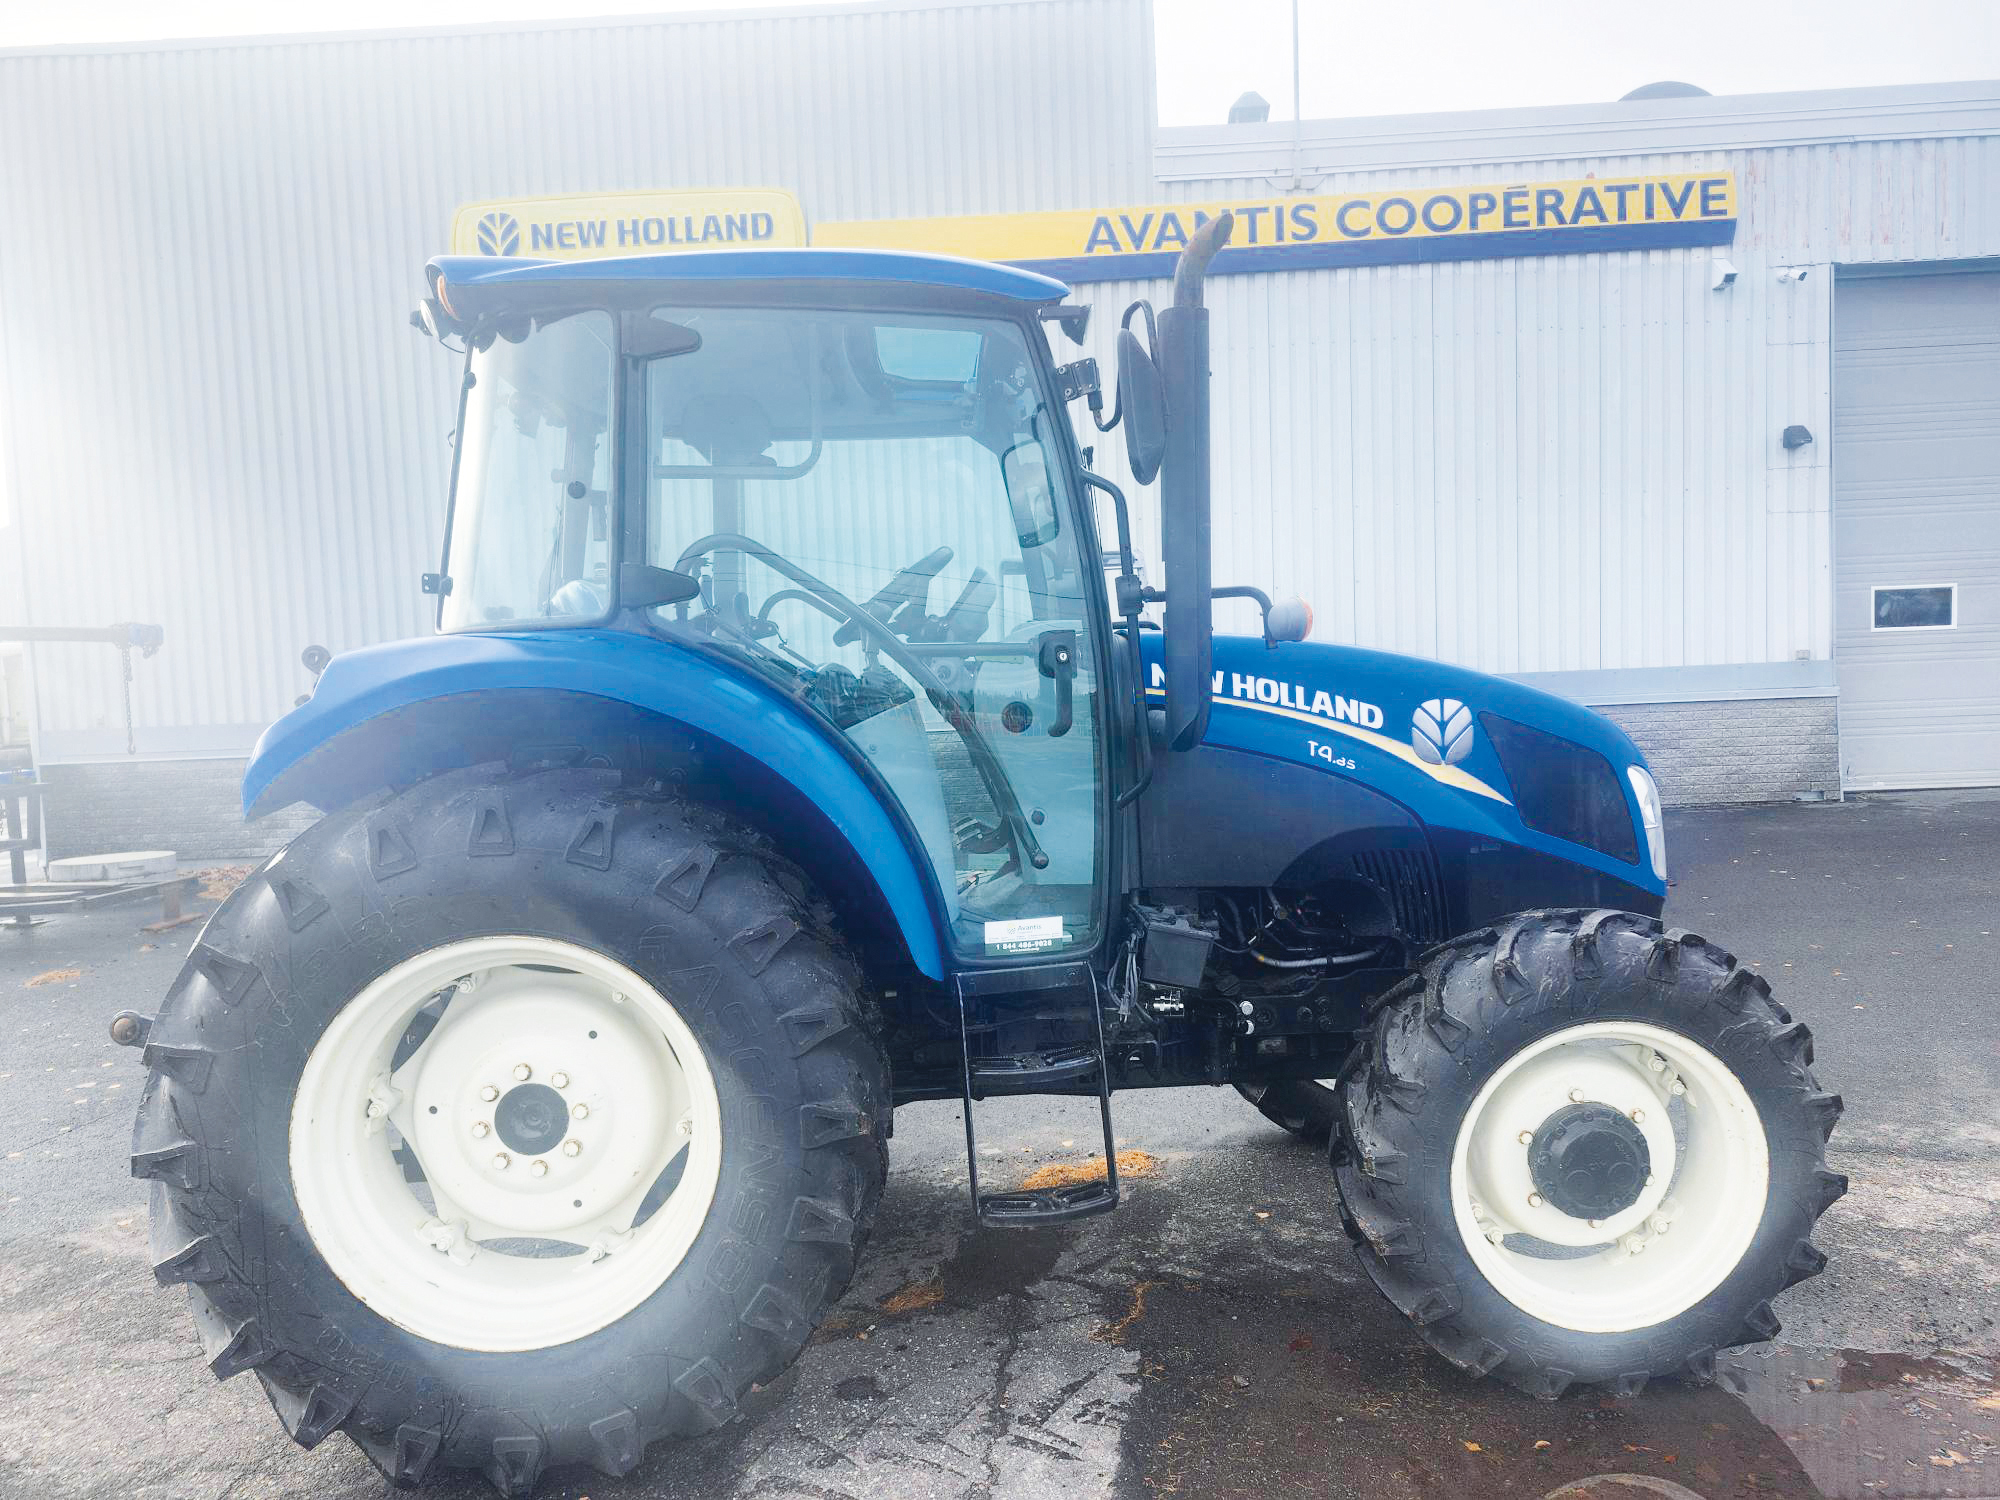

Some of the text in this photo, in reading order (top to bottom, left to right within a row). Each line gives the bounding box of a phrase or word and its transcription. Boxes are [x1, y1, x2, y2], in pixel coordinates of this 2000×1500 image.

[531, 212, 774, 252] NEW HOLLAND
[1335, 178, 1728, 238] COOPÉRATIVE
[1232, 672, 1384, 730] HOLLAND
[1307, 740, 1356, 770] T4.85
